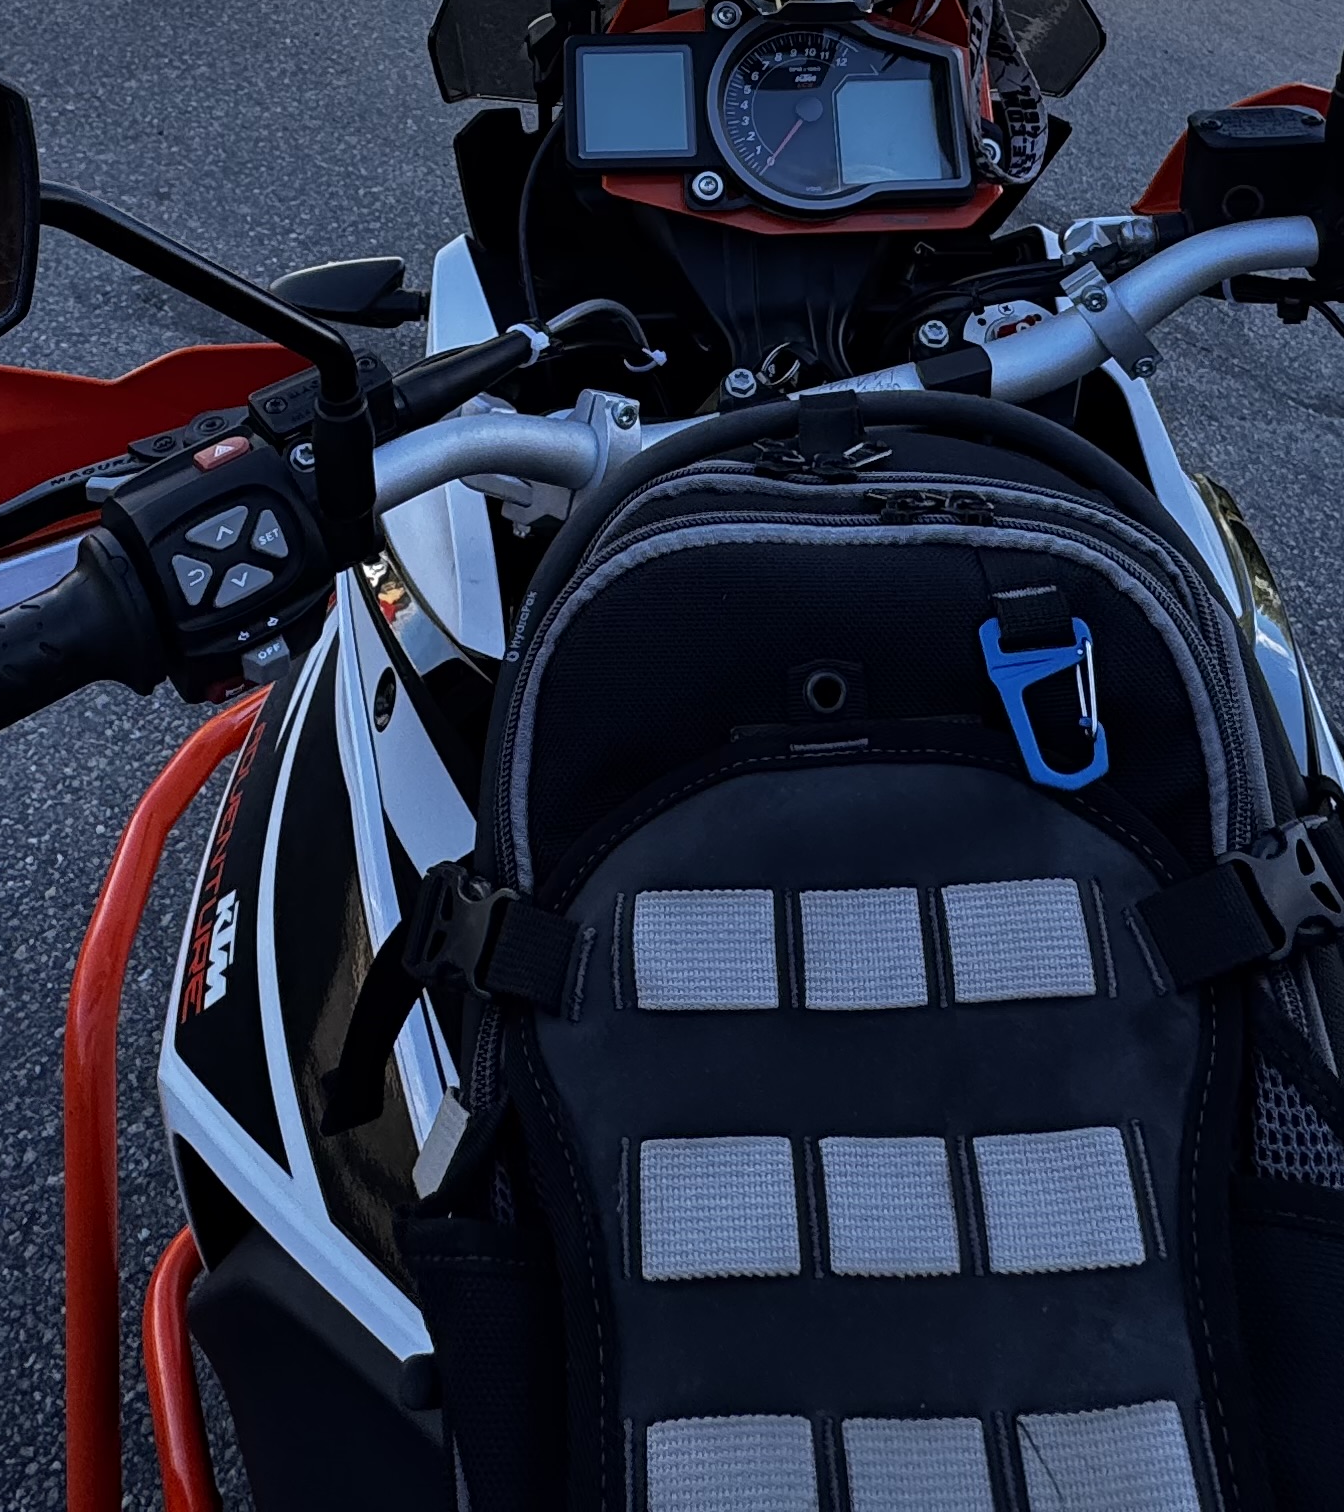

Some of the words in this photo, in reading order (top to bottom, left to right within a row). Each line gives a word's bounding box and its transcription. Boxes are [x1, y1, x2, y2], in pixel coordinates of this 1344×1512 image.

[774, 52, 783, 62] 8
[790, 48, 798, 58] 9
[804, 47, 817, 57] 10
[820, 51, 830, 60] 11
[761, 60, 770, 71] 7
[835, 57, 848, 67] 12
[751, 71, 759, 81] 6
[743, 84, 752, 95] 5
[740, 99, 749, 110] 4
[741, 115, 750, 126] 3
[746, 131, 755, 141] 2
[755, 144, 762, 155] 1
[50, 455, 138, 487] MAGURA
[258, 527, 280, 546] SET
[257, 642, 281, 660] OFF
[180, 721, 267, 1025] ADVENTURE
[203, 888, 240, 1010] KTM
